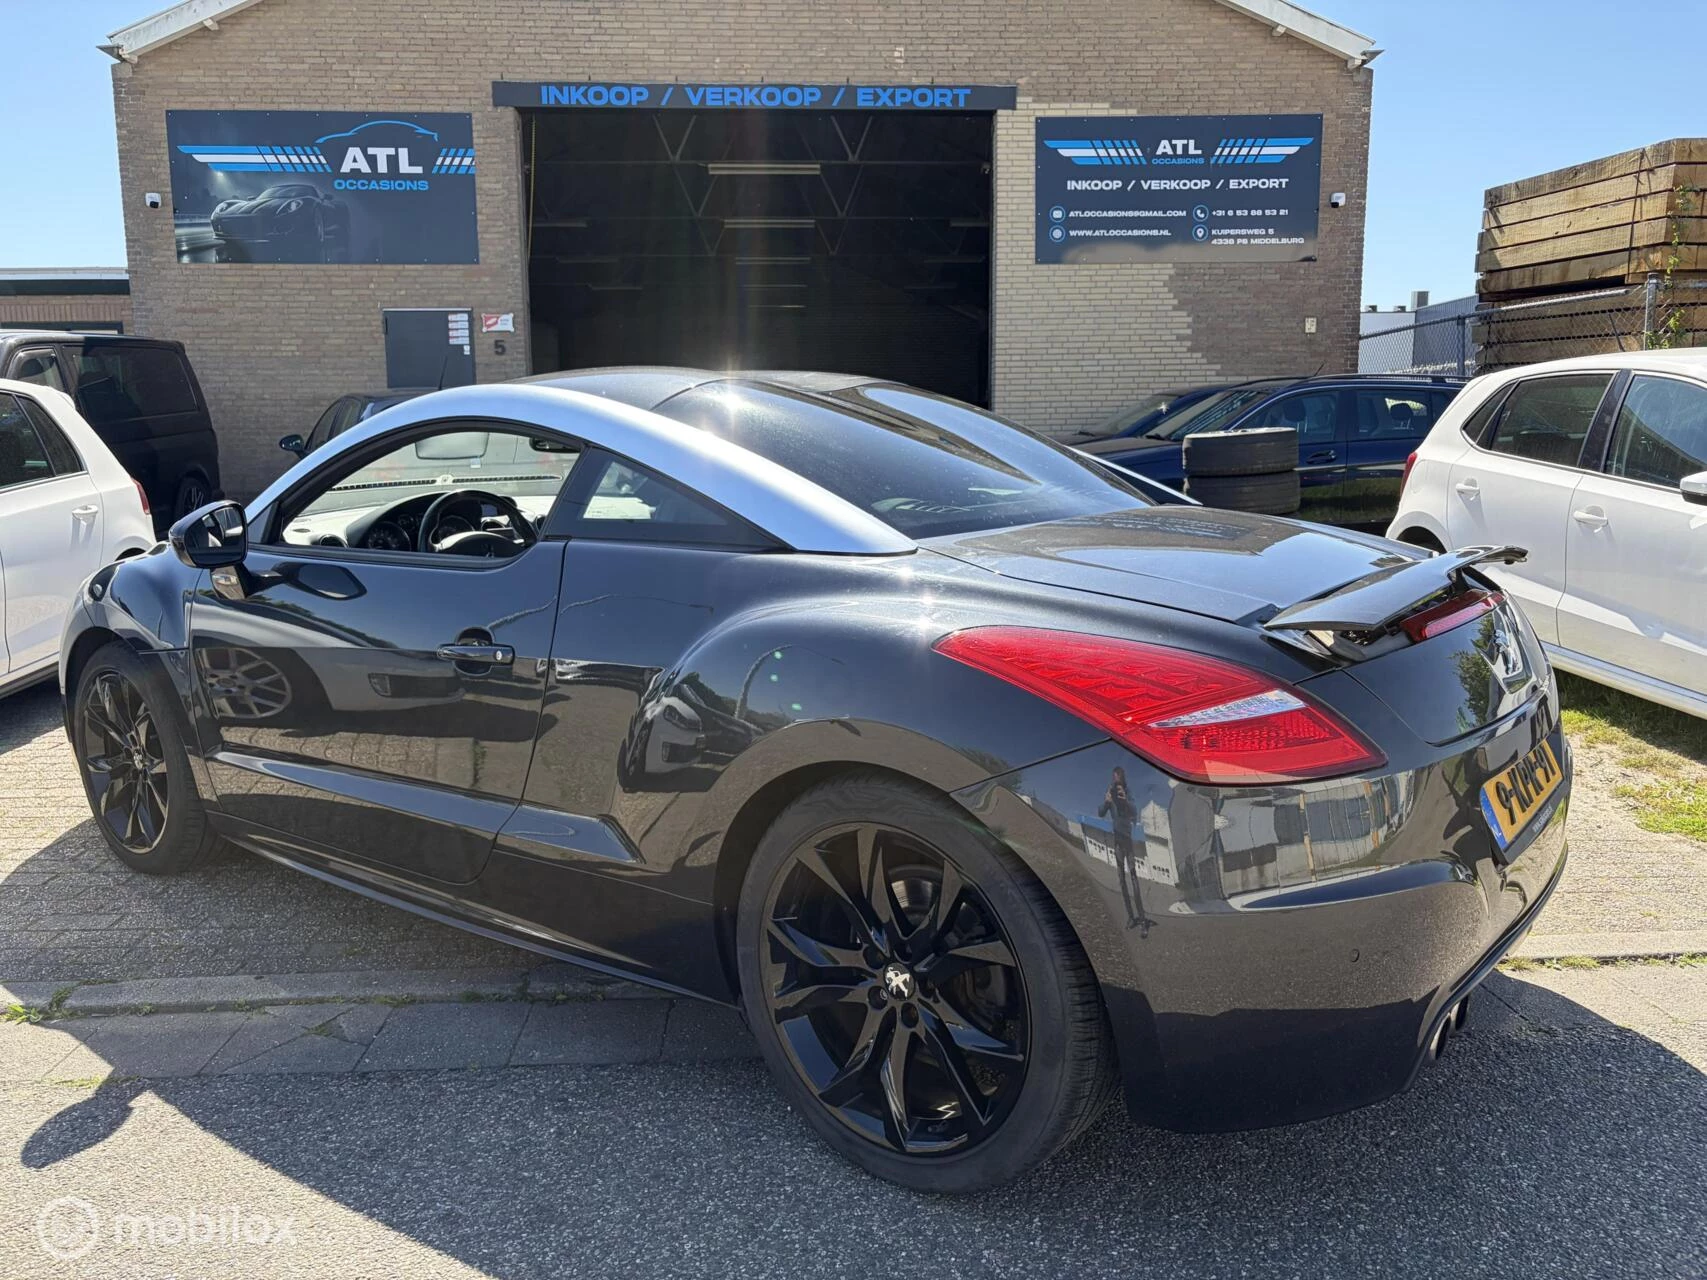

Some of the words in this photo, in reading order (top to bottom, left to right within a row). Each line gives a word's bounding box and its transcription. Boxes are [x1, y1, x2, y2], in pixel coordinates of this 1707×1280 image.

[541, 85, 649, 105] INKOOP
[660, 87, 674, 105] /
[684, 86, 821, 106] VERKOOP
[832, 87, 845, 106] /
[856, 87, 971, 107] EXPORT
[1155, 139, 1202, 155] ATL
[340, 147, 423, 174] ATL
[1151, 157, 1205, 165] OCCASIONS
[333, 179, 429, 191] OCCASIONS
[1066, 180, 1122, 191] INKOOP
[1127, 180, 1136, 191] /
[1141, 179, 1211, 190] VERKOOP
[1215, 179, 1224, 190] /
[1229, 178, 1289, 190] EXPORT
[494, 339, 507, 356] 5
